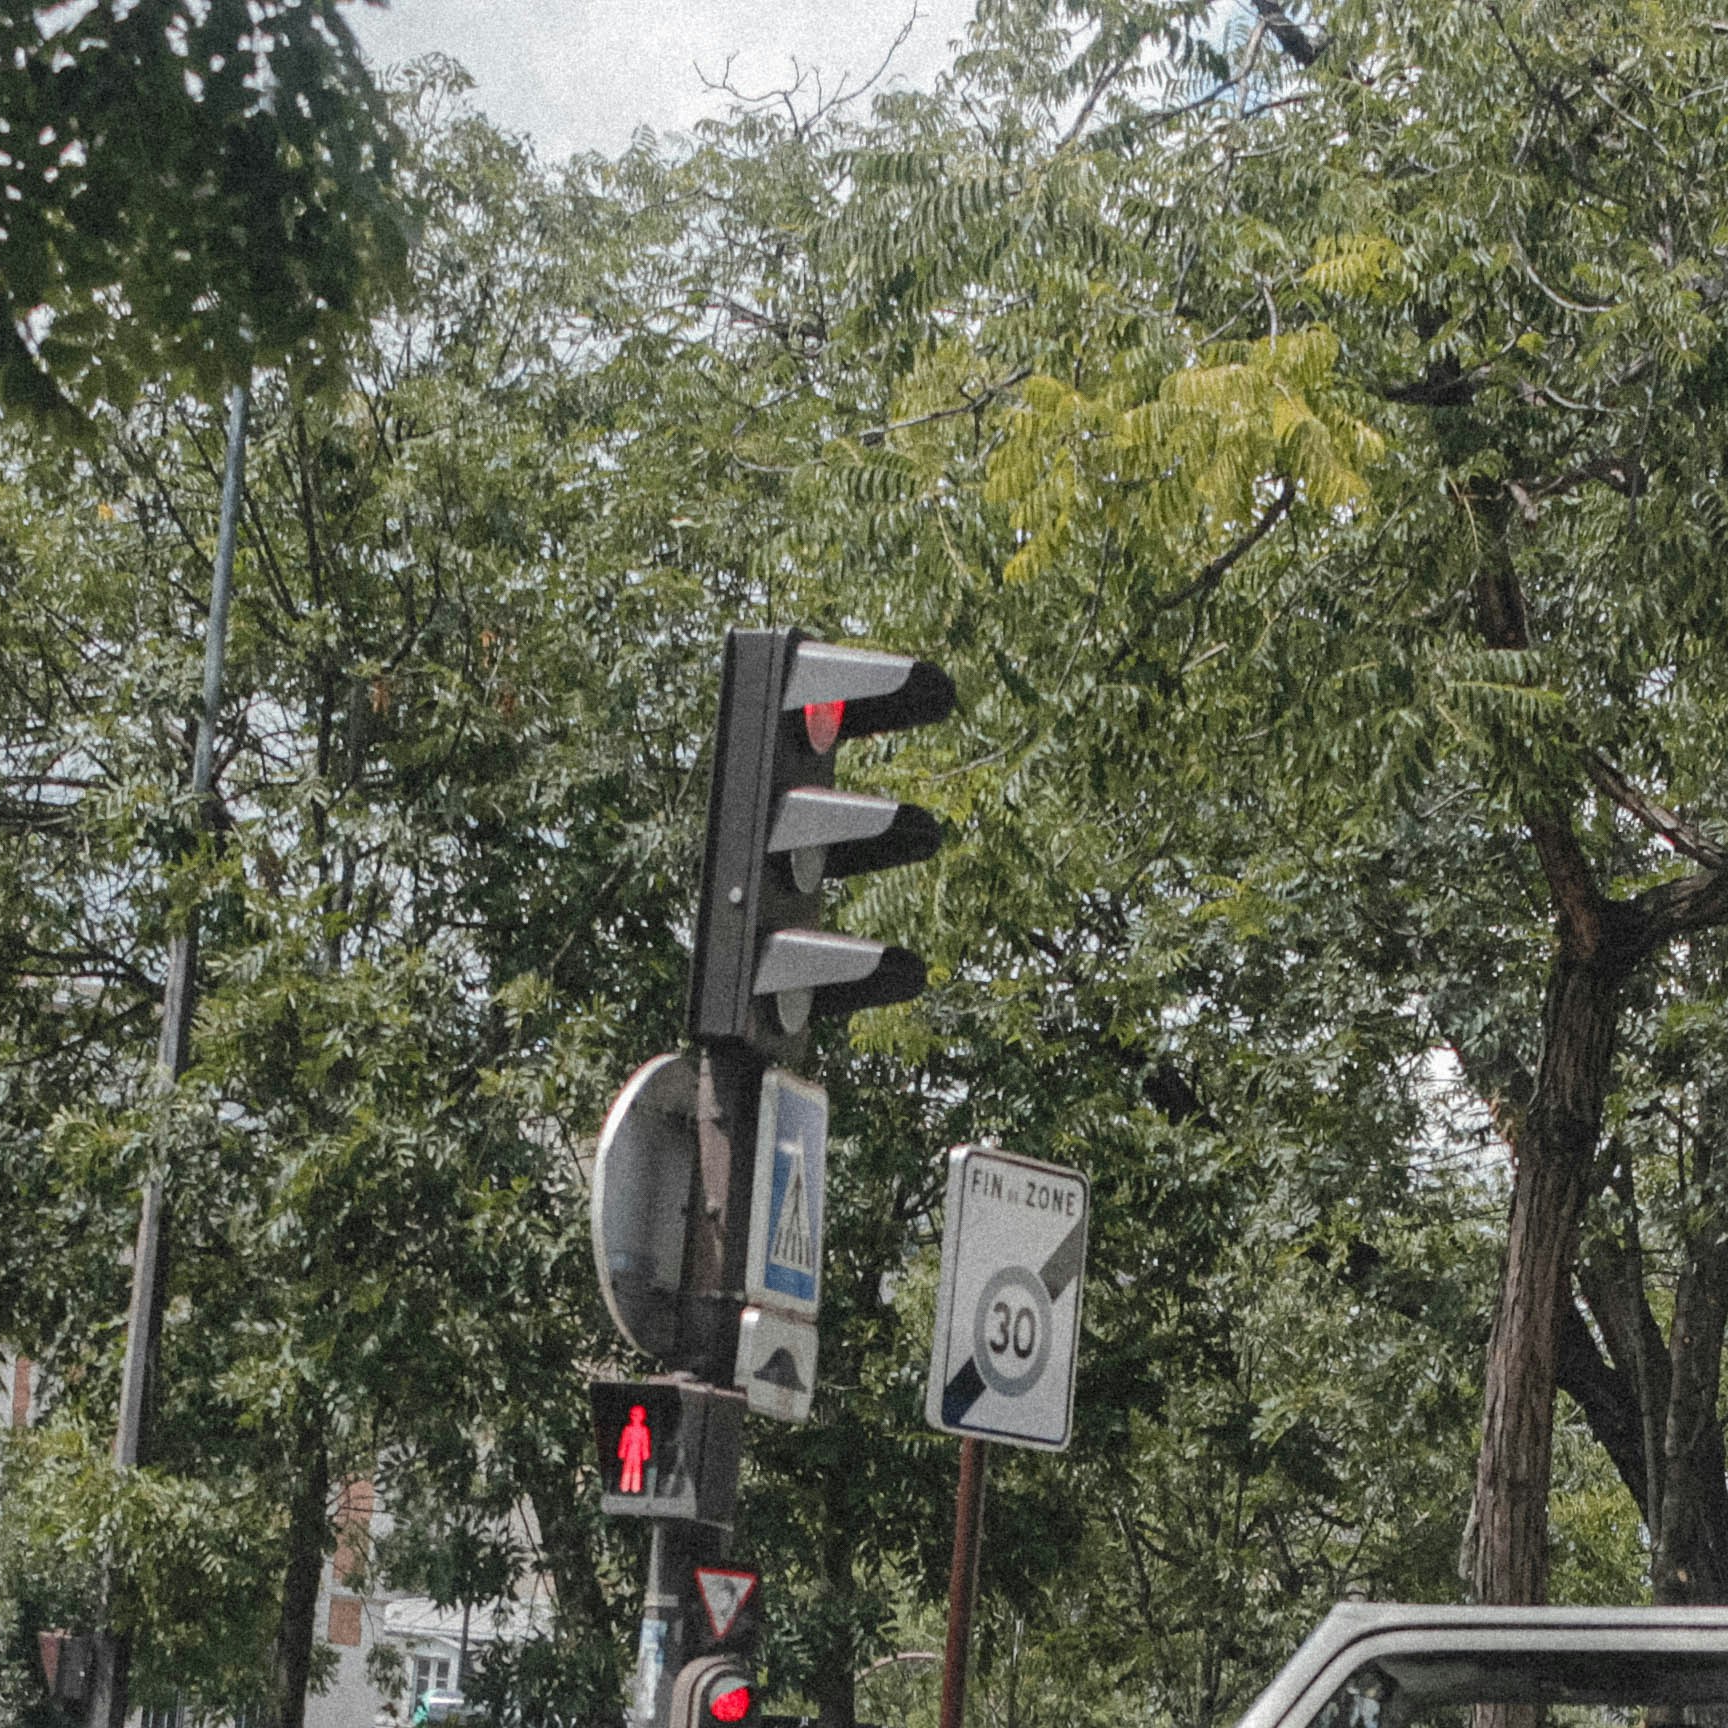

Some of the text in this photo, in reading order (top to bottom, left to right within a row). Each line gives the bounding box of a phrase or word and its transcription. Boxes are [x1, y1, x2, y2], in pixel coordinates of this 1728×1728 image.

[971, 1168, 1003, 1200] FIN
[1026, 1181, 1076, 1217] ZONE
[990, 1302, 1036, 1359] 30
